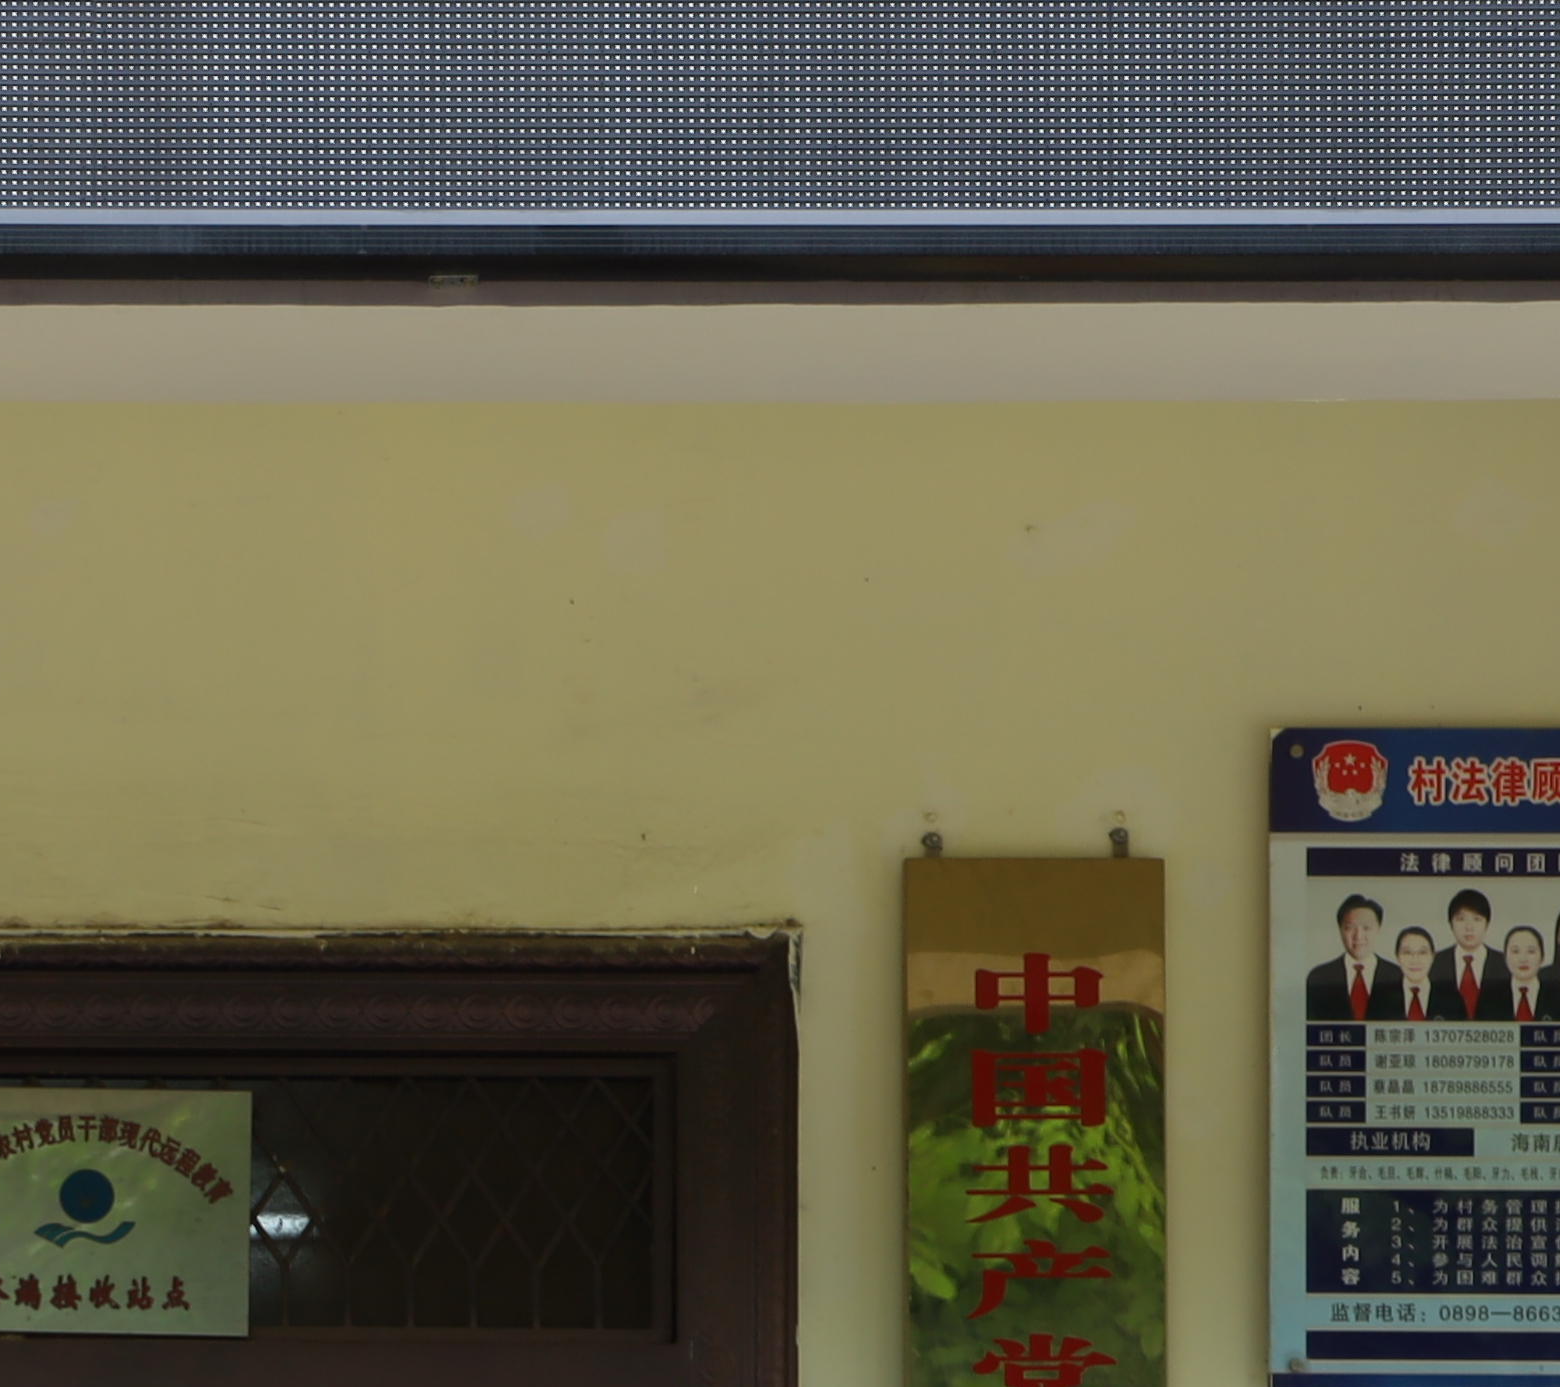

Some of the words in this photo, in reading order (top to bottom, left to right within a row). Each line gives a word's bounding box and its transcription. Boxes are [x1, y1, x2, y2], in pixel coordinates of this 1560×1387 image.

[1424, 1030, 1515, 1044] 13707528028
[1319, 1056, 1352, 1068] 队员
[1424, 1055, 1515, 1069] 18089799178
[1319, 1081, 1352, 1094] 队员
[1423, 1080, 1513, 1095] 18789886555
[1319, 1106, 1352, 1119] 队员
[1424, 1105, 1515, 1120] 13519888333
[1350, 1131, 1431, 1152] 执业机构
[1342, 1197, 1360, 1285] 服务内容
